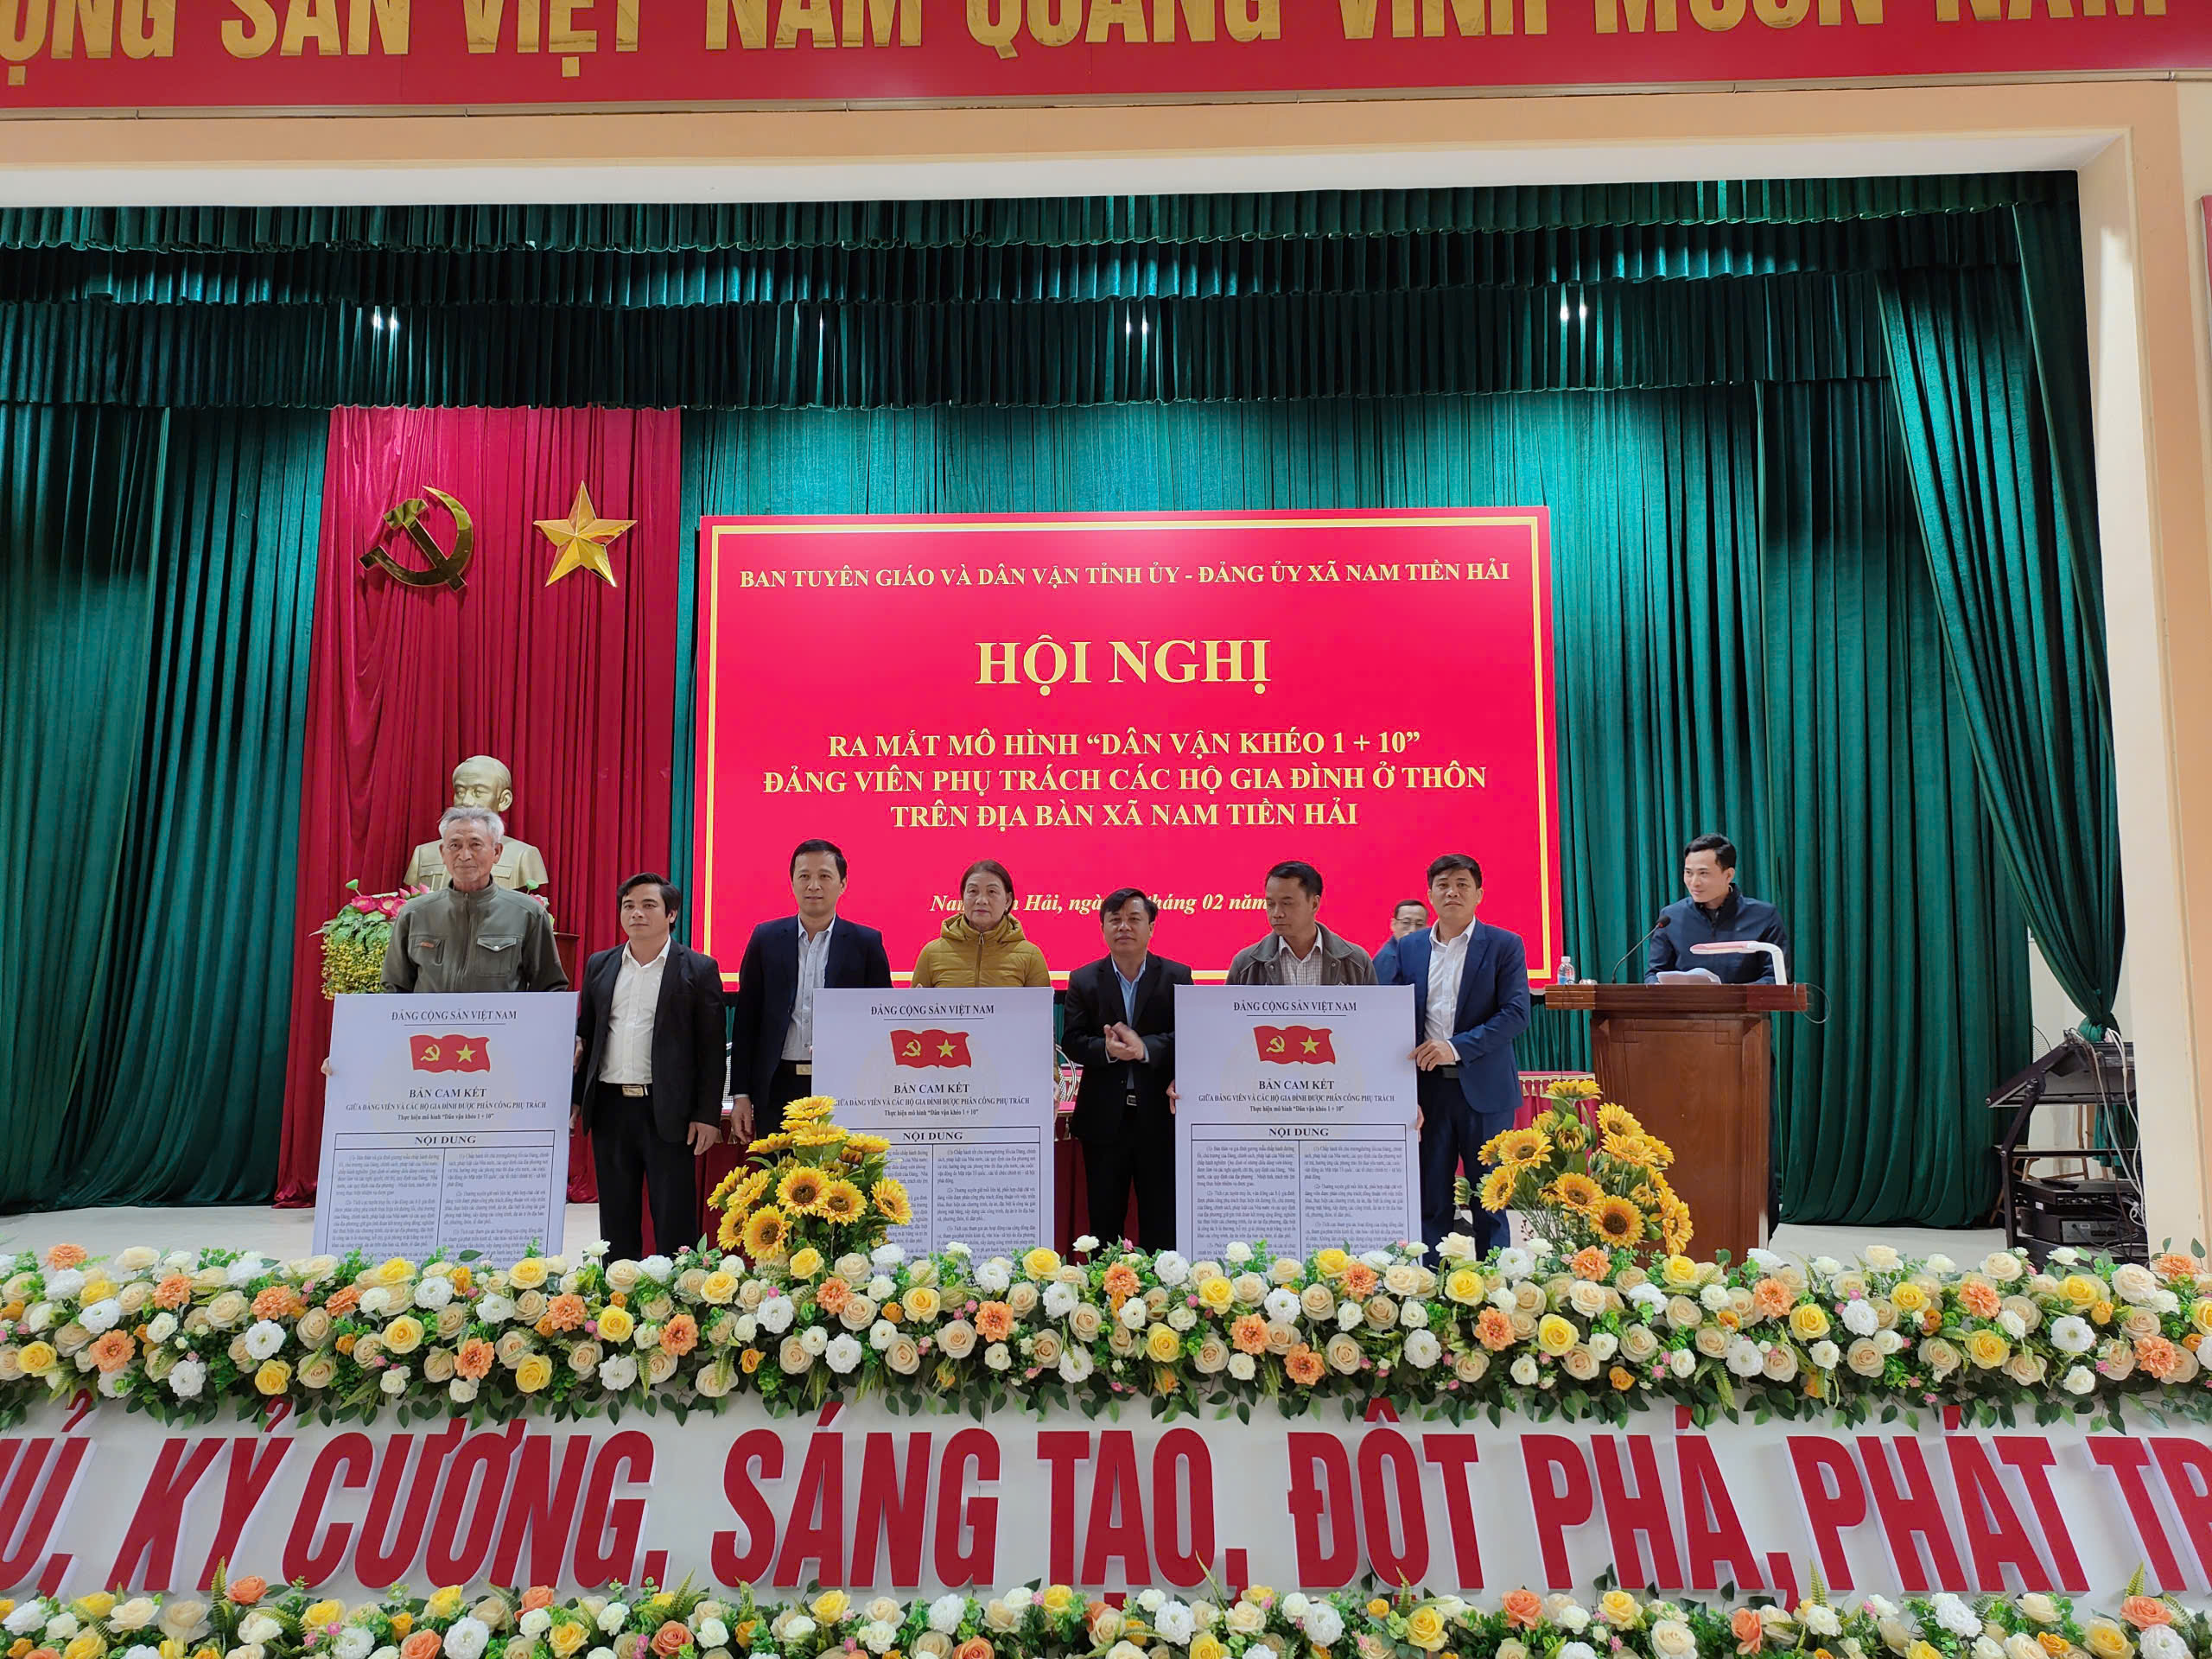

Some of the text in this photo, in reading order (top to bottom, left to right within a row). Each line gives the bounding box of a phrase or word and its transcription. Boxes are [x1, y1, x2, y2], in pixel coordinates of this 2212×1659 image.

[739, 570, 787, 588] BAN
[791, 564, 870, 588] TUYÊN
[875, 563, 935, 587] GIÁO
[939, 563, 973, 586] VÀ
[977, 563, 1027, 586] DÂN
[1031, 565, 1080, 589] VẬN
[1084, 562, 1143, 584] TỈNH
[1147, 561, 1180, 584] ỦY
[1198, 561, 1265, 583] ĐẢNG
[1269, 560, 1303, 582] ỦY
[1306, 560, 1341, 582] XÃ
[1345, 563, 1401, 582] NAM
[1404, 558, 1461, 581] TIỀN
[1465, 557, 1510, 581] HẢI
[974, 634, 1271, 696] HỘI NGHỊ
[828, 726, 1421, 760] RA MẮT MÔ HÌNH “DÂN VẬN KHÉO 1 + 10”
[763, 760, 1487, 797] ĐẢNG VIÊN PHỤ TRÁCH CÁC HỘ GIA ĐÌNH Ở THÔN
[890, 797, 1358, 832] TRÊN ĐỊA BÀN XÃ NAM TIỀN HẢI
[1023, 893, 1064, 913] Hải,
[1068, 890, 1103, 915] ngà
[1201, 893, 1224, 910] 02
[871, 1003, 995, 1016] ĐẢNG CỘNG SẢN VIỆT NAM
[1234, 999, 1357, 1013] ĐẢNG CỘNG SẢN VIỆT NAM
[391, 1008, 517, 1022] ĐẢNG CỘNG SẢN VIỆT NAM
[893, 1082, 970, 1094] BẢN CAM KẾT
[1259, 1078, 1335, 1090] BẢN CAM KẾT
[409, 1086, 487, 1098] BẢN CAM KẾT
[902, 1131, 963, 1142] NỘI DUNG
[1268, 1127, 1329, 1138] NỘI DUNG
[414, 1135, 477, 1146] NỘI DUNG
[0, 1389, 91, 1599] Ủ,
[105, 1395, 294, 1592] KỶ
[711, 1402, 1000, 1588] SÁNG
[1036, 1429, 1249, 1611] TẠO,
[1287, 1397, 1484, 1605] ĐỘT
[1521, 1405, 1800, 1613] PHÁ,
[1786, 1405, 2091, 1592] PHÁT
